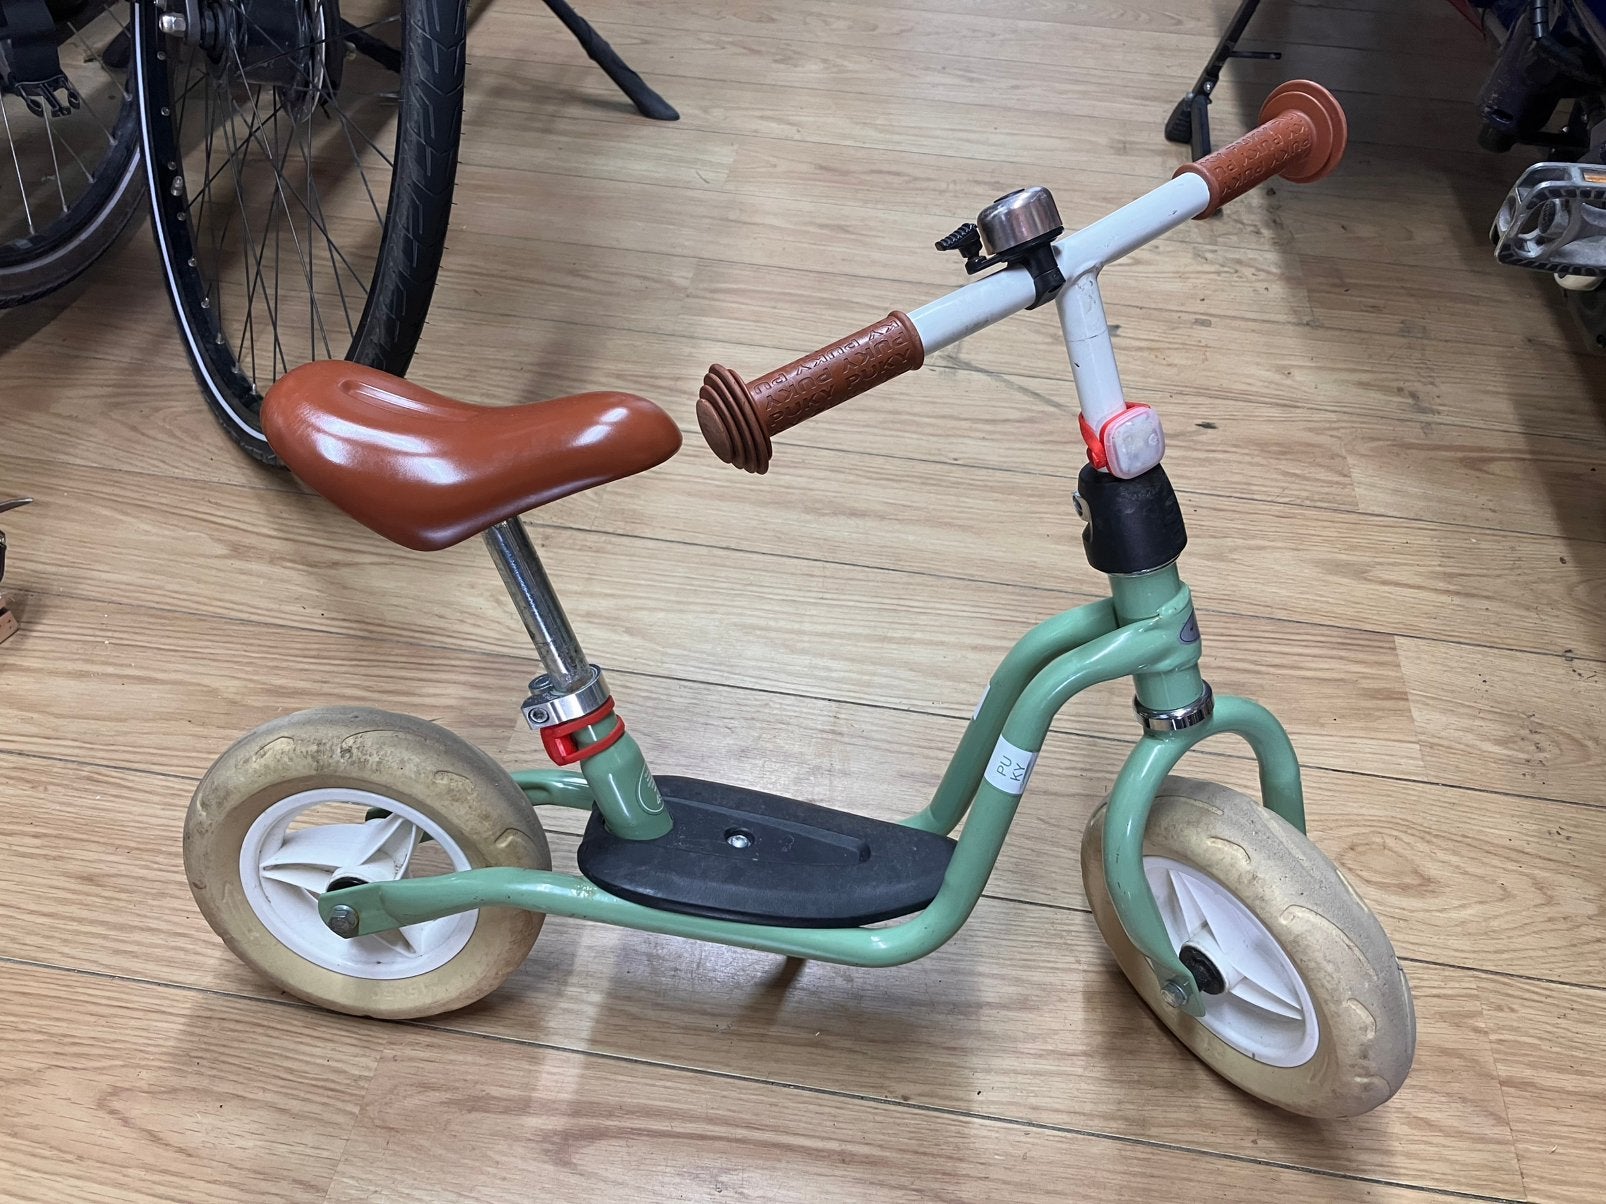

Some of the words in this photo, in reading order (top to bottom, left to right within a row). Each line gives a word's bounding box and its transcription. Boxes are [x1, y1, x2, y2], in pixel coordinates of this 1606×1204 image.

[868, 320, 900, 341] KY
[796, 338, 860, 376] PUKY
[842, 331, 912, 375] PUKY
[753, 373, 788, 395] PU
[766, 367, 833, 411] PUKY
[768, 384, 835, 428] PUKY
[846, 348, 911, 390] PUKY
[997, 756, 1012, 776] PU
[1010, 763, 1025, 781] KY
